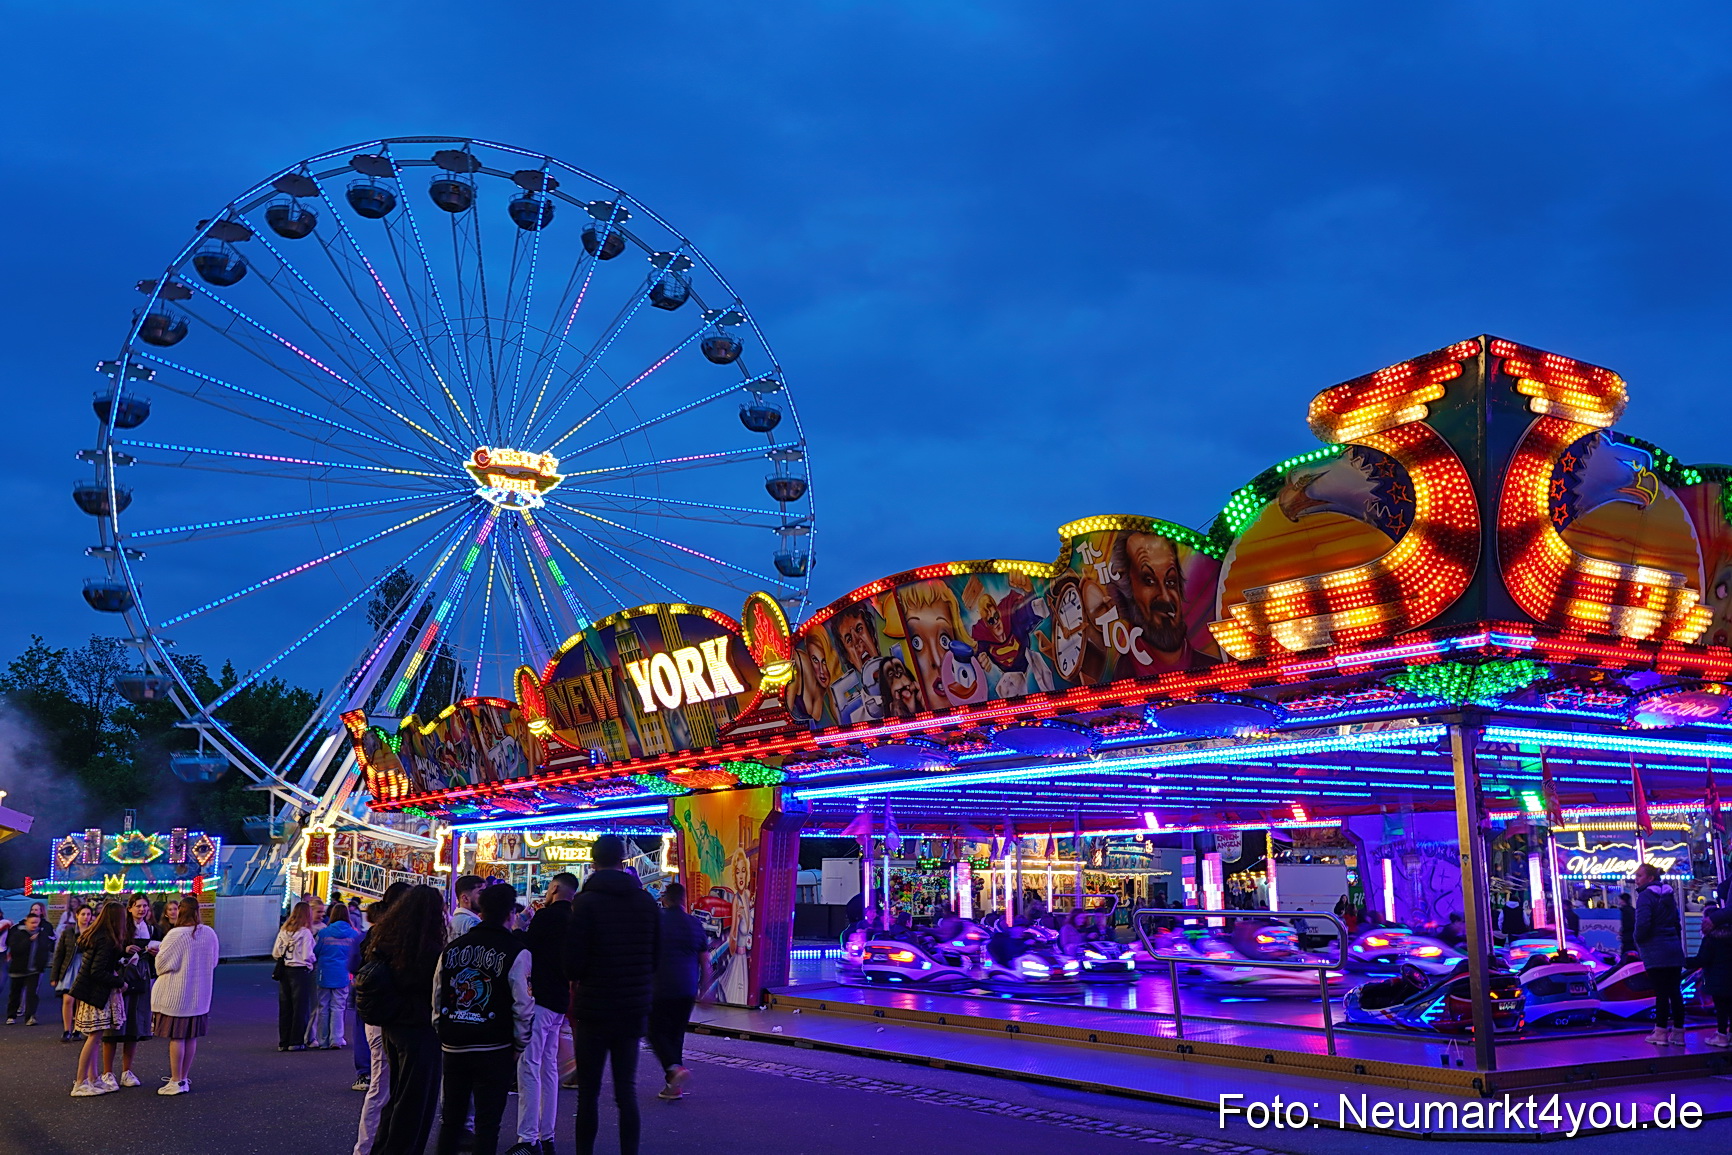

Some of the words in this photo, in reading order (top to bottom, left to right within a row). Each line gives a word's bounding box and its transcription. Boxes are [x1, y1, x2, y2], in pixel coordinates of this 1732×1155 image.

[487, 473, 540, 494] WHEEL
[1076, 541, 1102, 565] TIC
[1094, 561, 1120, 585] TIC
[1095, 605, 1153, 665] TOC
[545, 668, 618, 731] NEW
[626, 635, 745, 713] YORK
[1217, 841, 1241, 850] ANGELN
